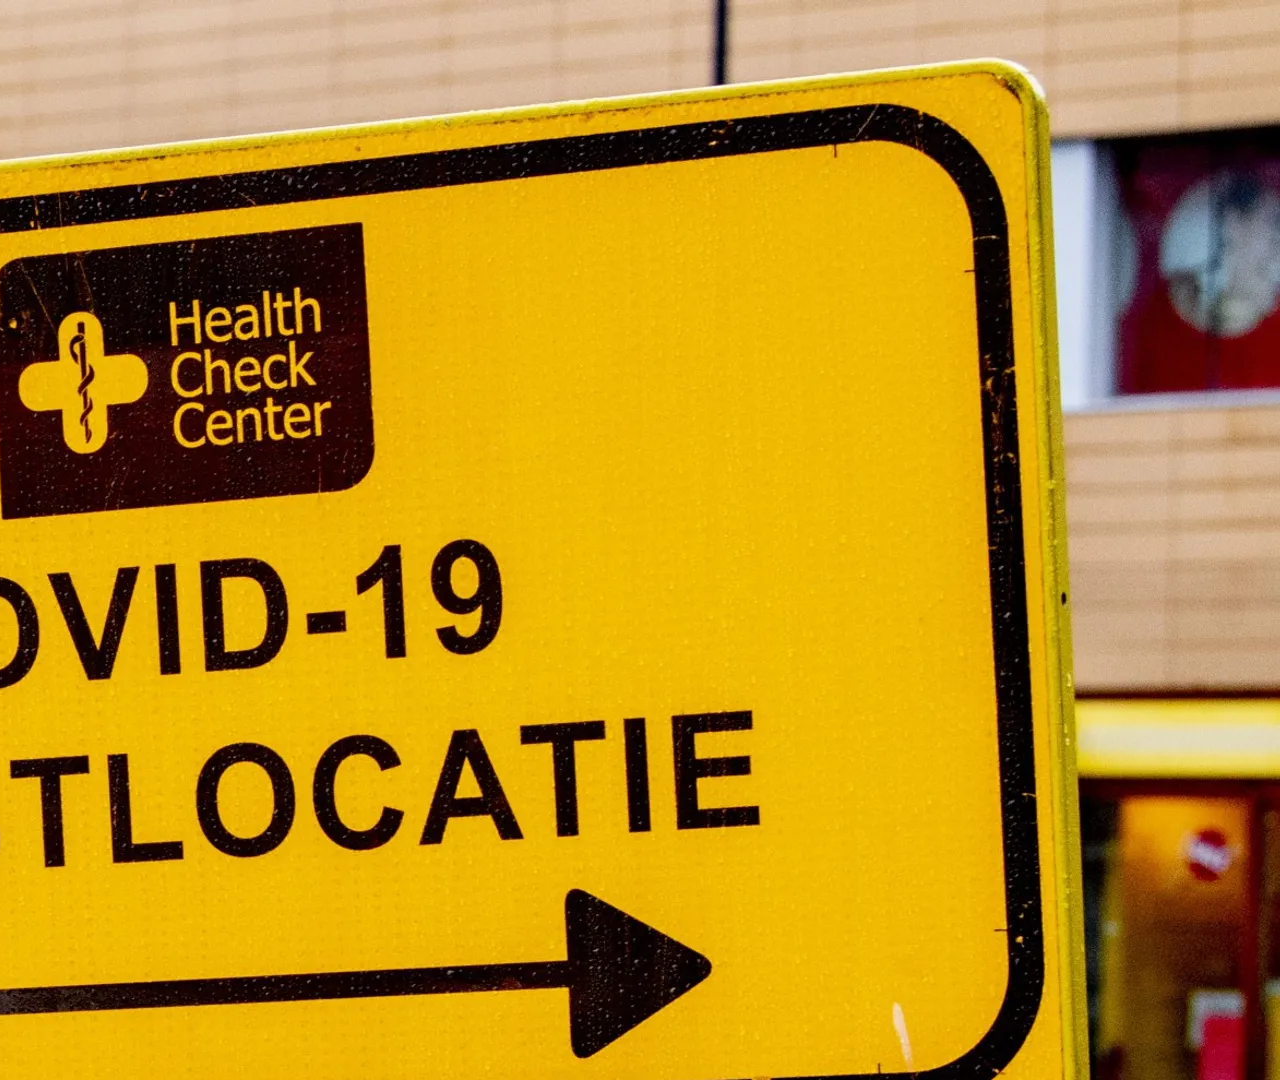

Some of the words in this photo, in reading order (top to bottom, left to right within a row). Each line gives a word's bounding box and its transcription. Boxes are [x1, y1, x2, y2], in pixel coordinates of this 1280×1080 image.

[168, 287, 322, 346] Health
[170, 341, 317, 398] Check
[173, 397, 332, 449] Center
